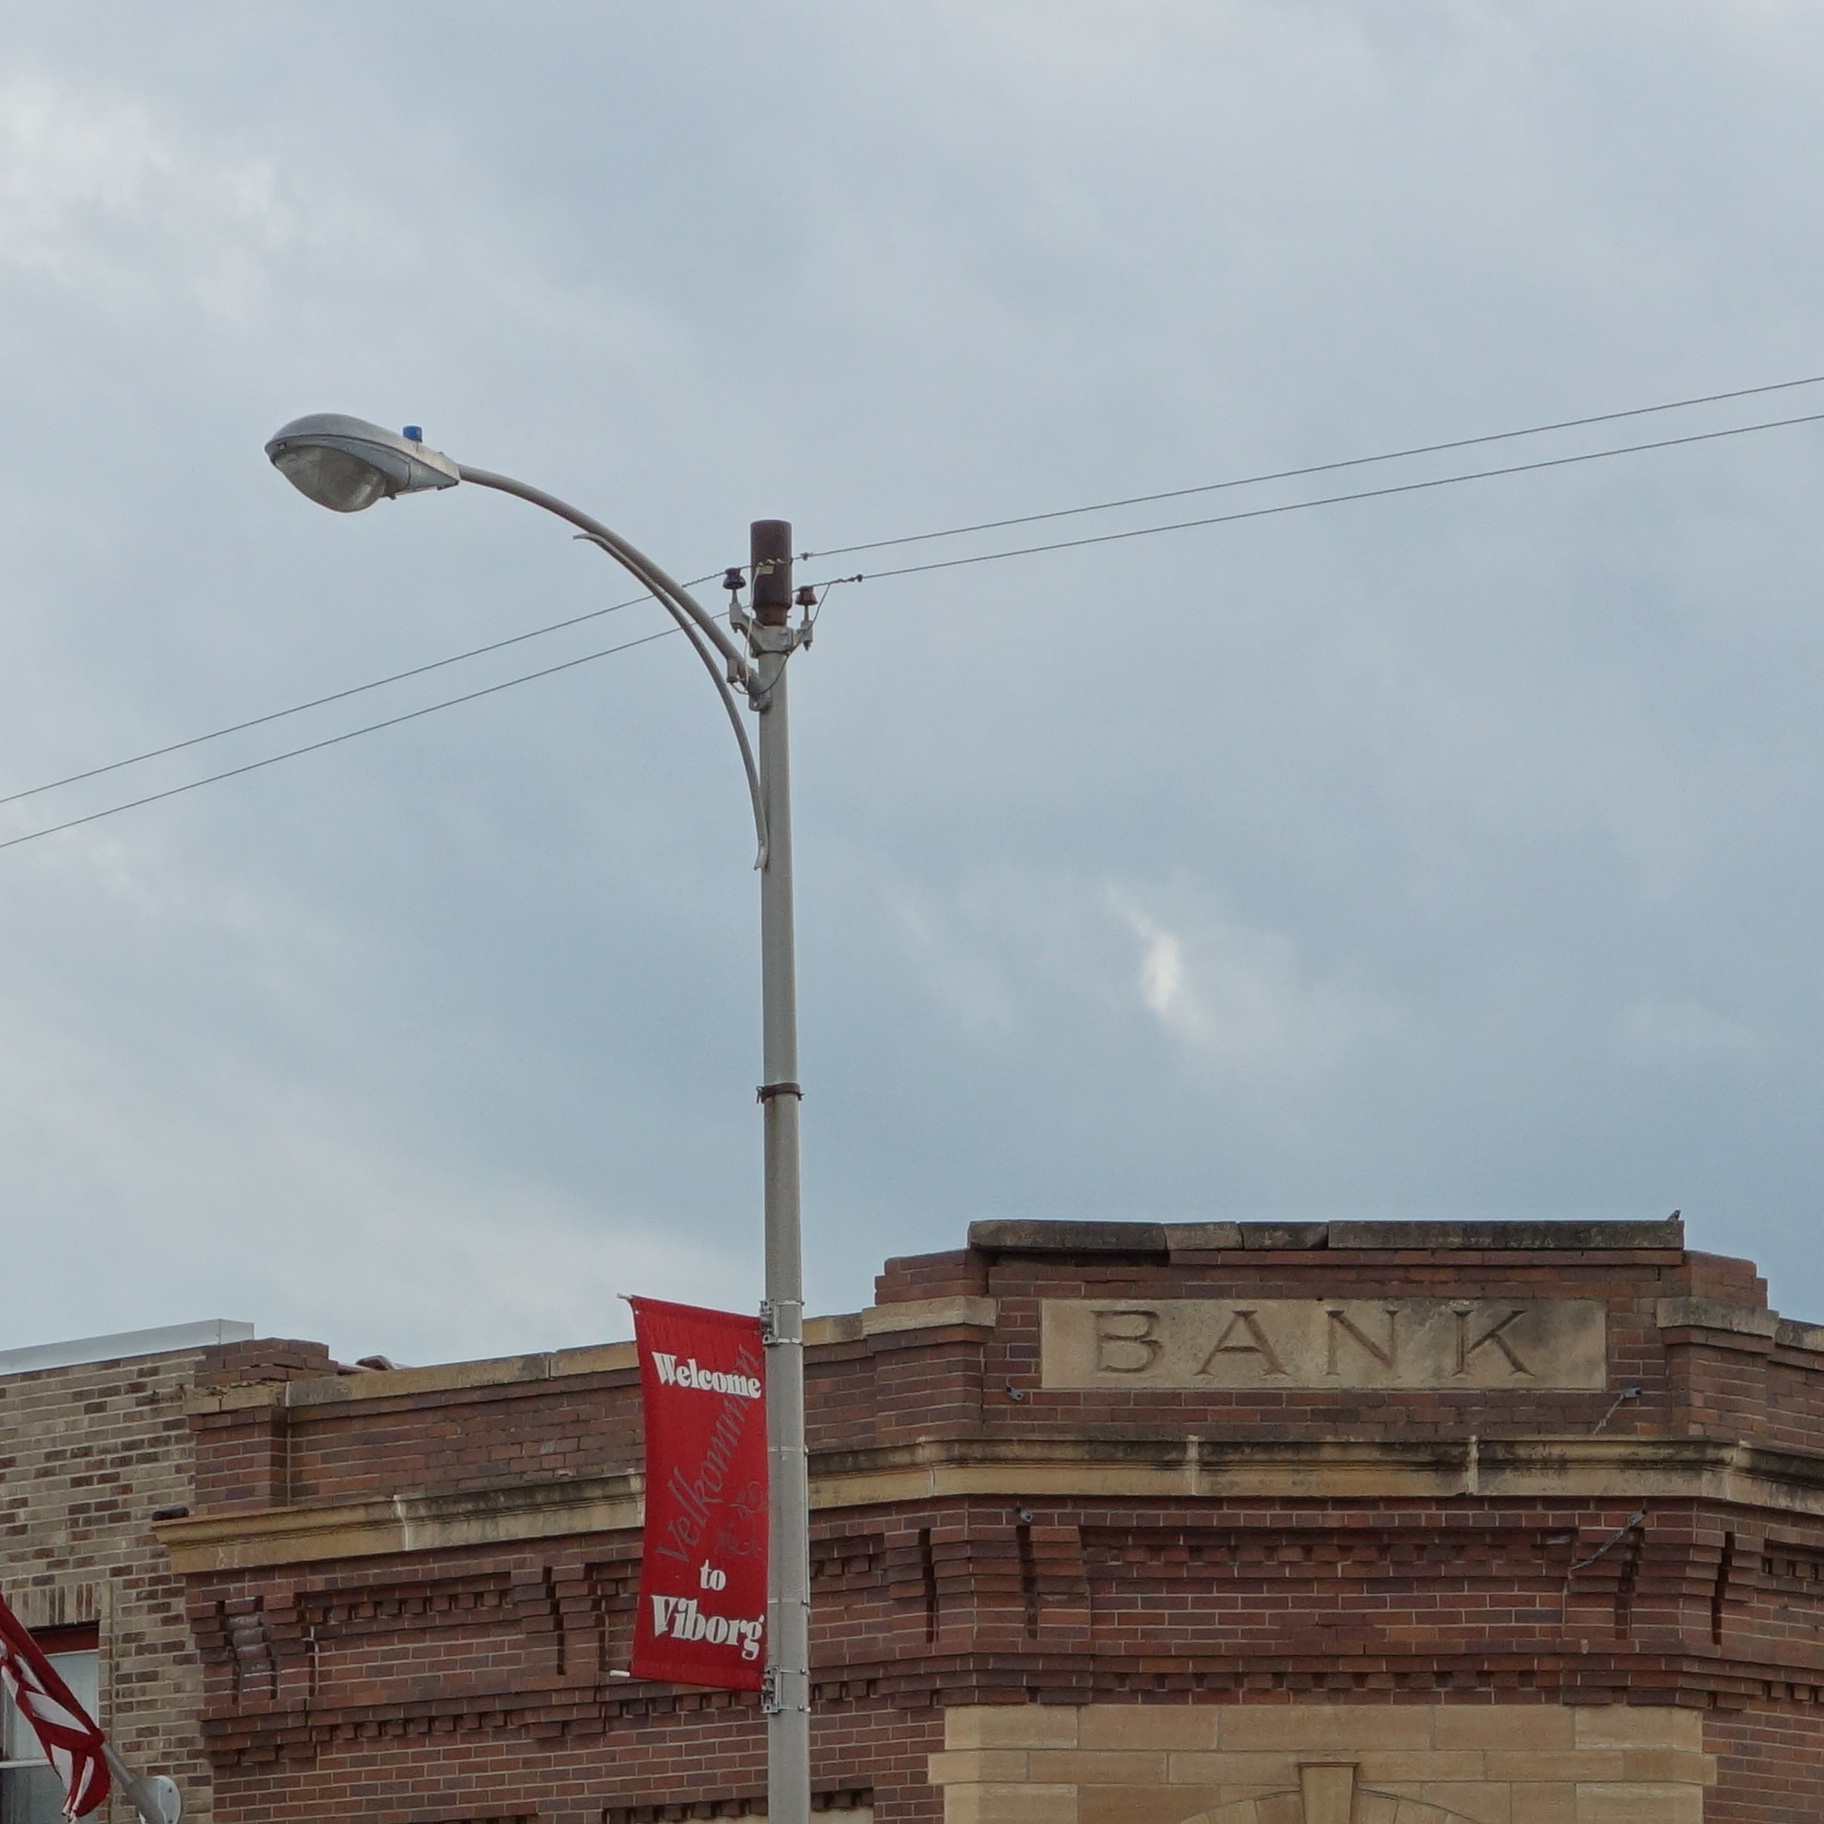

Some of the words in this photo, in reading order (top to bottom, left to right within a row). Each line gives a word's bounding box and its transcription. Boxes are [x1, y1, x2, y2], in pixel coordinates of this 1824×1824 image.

[1090, 1308, 1536, 1377] BANK
[651, 1350, 762, 1399] Welcome
[699, 1559, 727, 1591] to
[650, 1594, 765, 1661] Viborg
